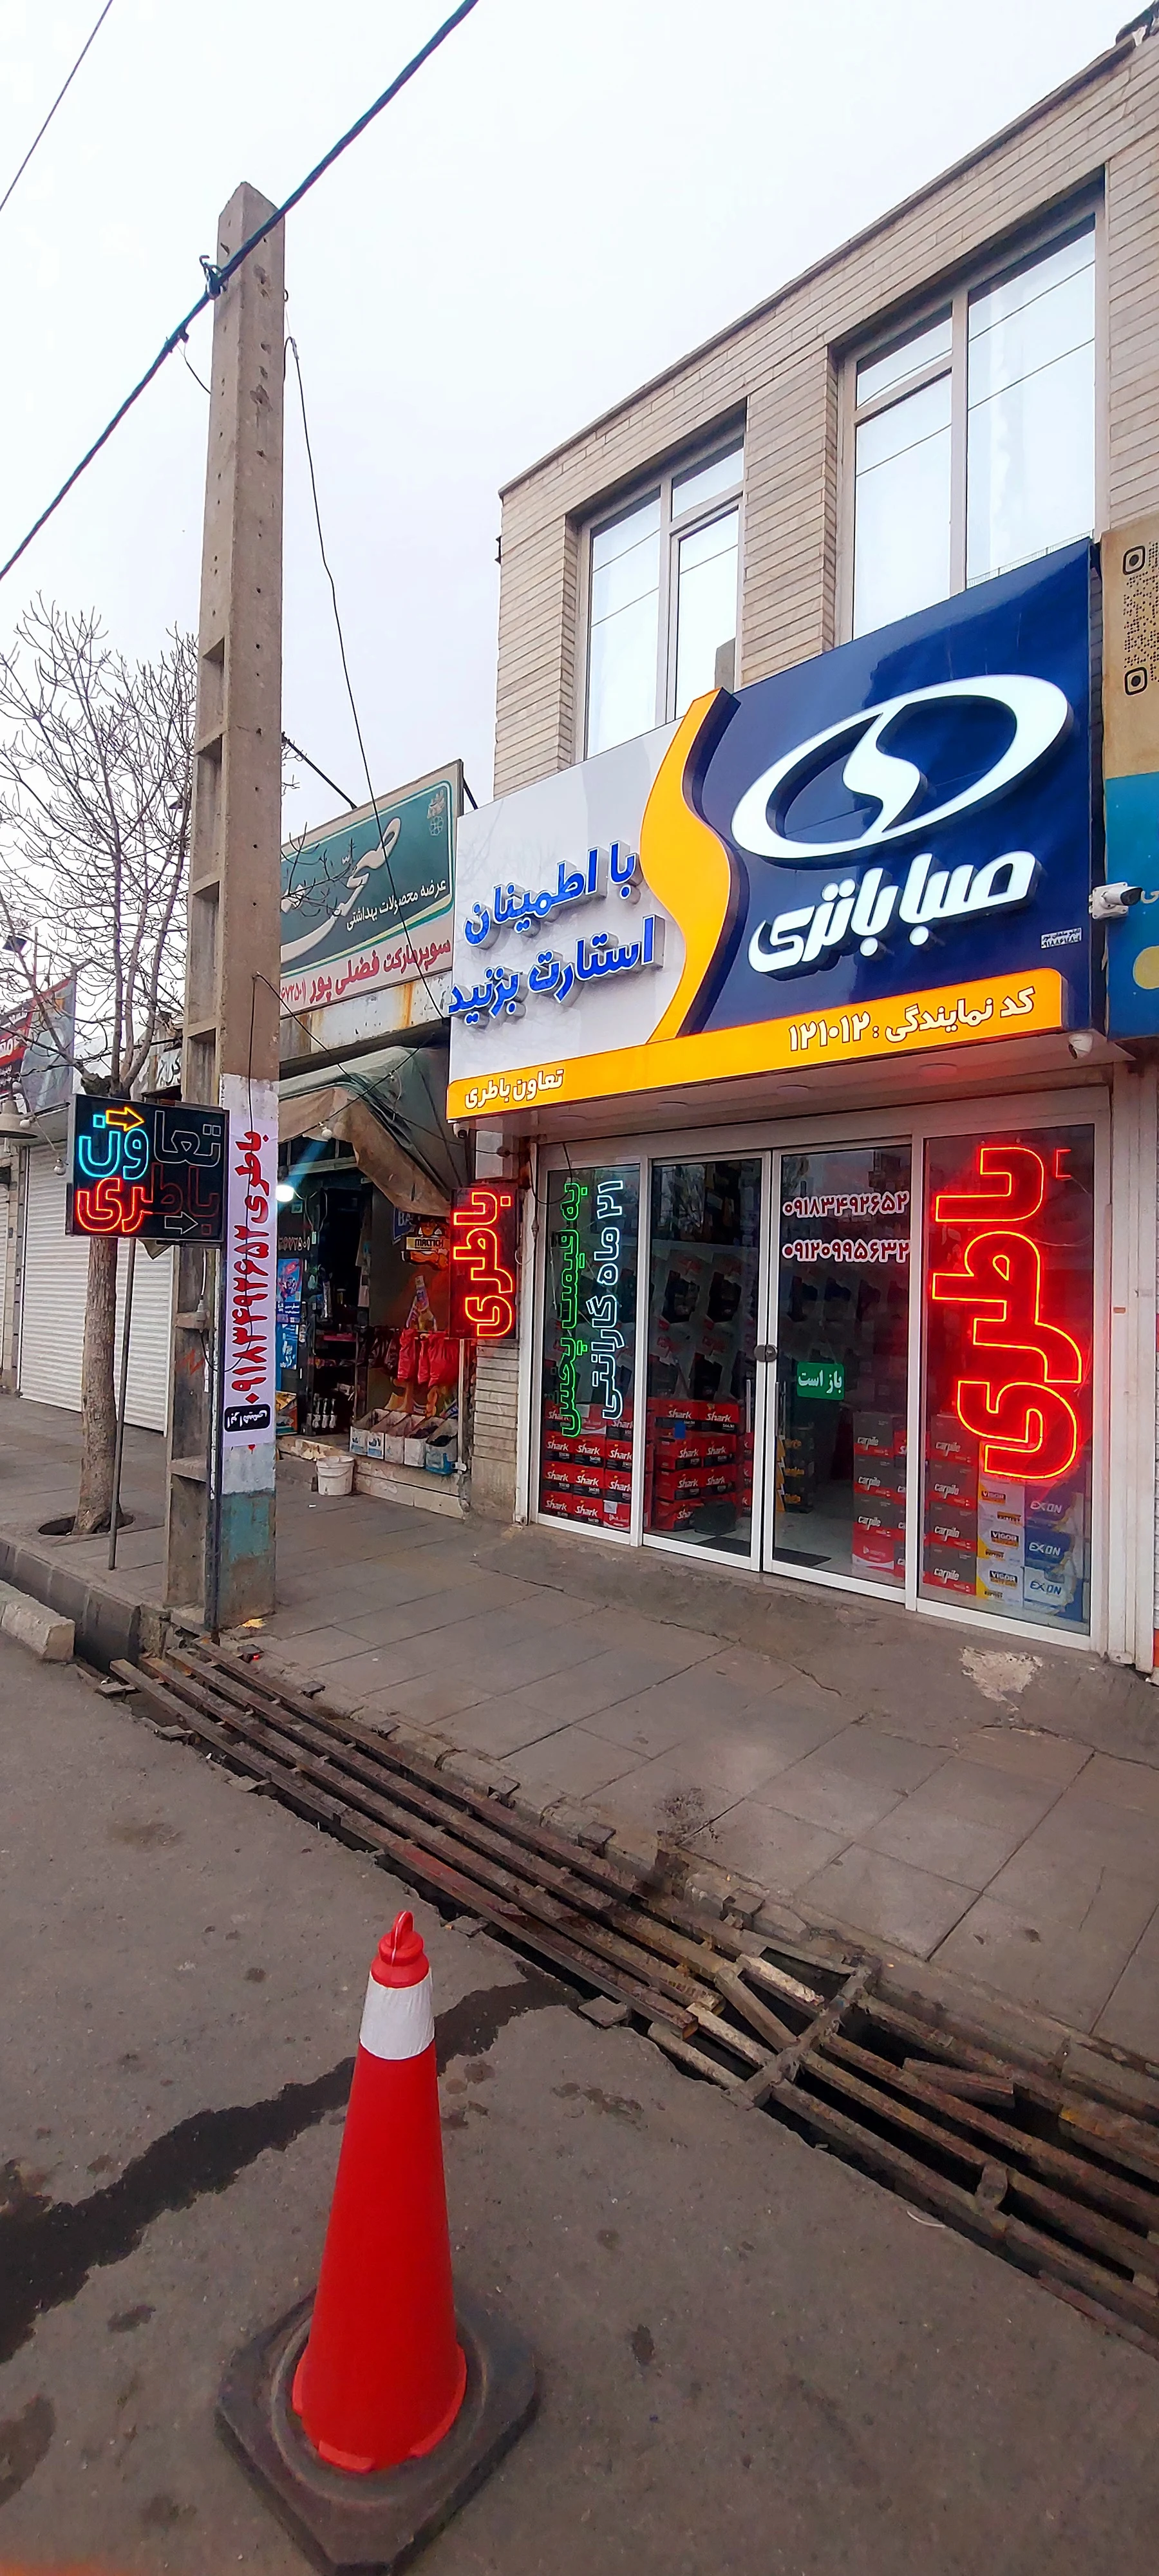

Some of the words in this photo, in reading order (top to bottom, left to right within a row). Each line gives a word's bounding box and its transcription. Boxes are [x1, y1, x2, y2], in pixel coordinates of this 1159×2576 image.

[420, 880, 447, 900] عرضه
[610, 840, 636, 898] با
[346, 905, 378, 931] بهداشتی
[379, 891, 419, 916] محصولات
[464, 846, 599, 948] اطمینان
[899, 851, 1036, 947] صبا
[748, 867, 900, 973] باتری
[335, 950, 381, 995] فضلی
[527, 914, 655, 1004] استارت
[310, 976, 332, 1003] پور
[448, 965, 520, 1025] بزنید
[999, 986, 1035, 1018] کد
[789, 1011, 871, 1052] ۱۲۱۰۱۲
[885, 997, 994, 1043] نمایندگی
[464, 1077, 511, 1109] باطری
[513, 1069, 565, 1101] تعاون
[79, 1110, 221, 1180] تعاون
[77, 1162, 221, 1235] باطری
[234, 1130, 270, 1224] باطری
[560, 1182, 588, 1221] به
[782, 1191, 910, 1218] ۰۹۱۸۳۴۹۲۶۵۲
[453, 1191, 513, 1337] باطری
[594, 1226, 620, 1286] ماه
[782, 1238, 910, 1263] ۰۹۱۲۰۹۹۵۶۳۲
[558, 1229, 585, 1329] قیمت
[231, 1224, 271, 1405] ۰۹۱۸۳۴۹۲۶۵۲
[932, 1146, 1083, 1479] باطری
[585, 1294, 624, 1420] گارانتی
[798, 1370, 824, 1389] است
[826, 1370, 843, 1394] باز
[1029, 1542, 1061, 1556] EXON
[1030, 1580, 1062, 1595] EXON
